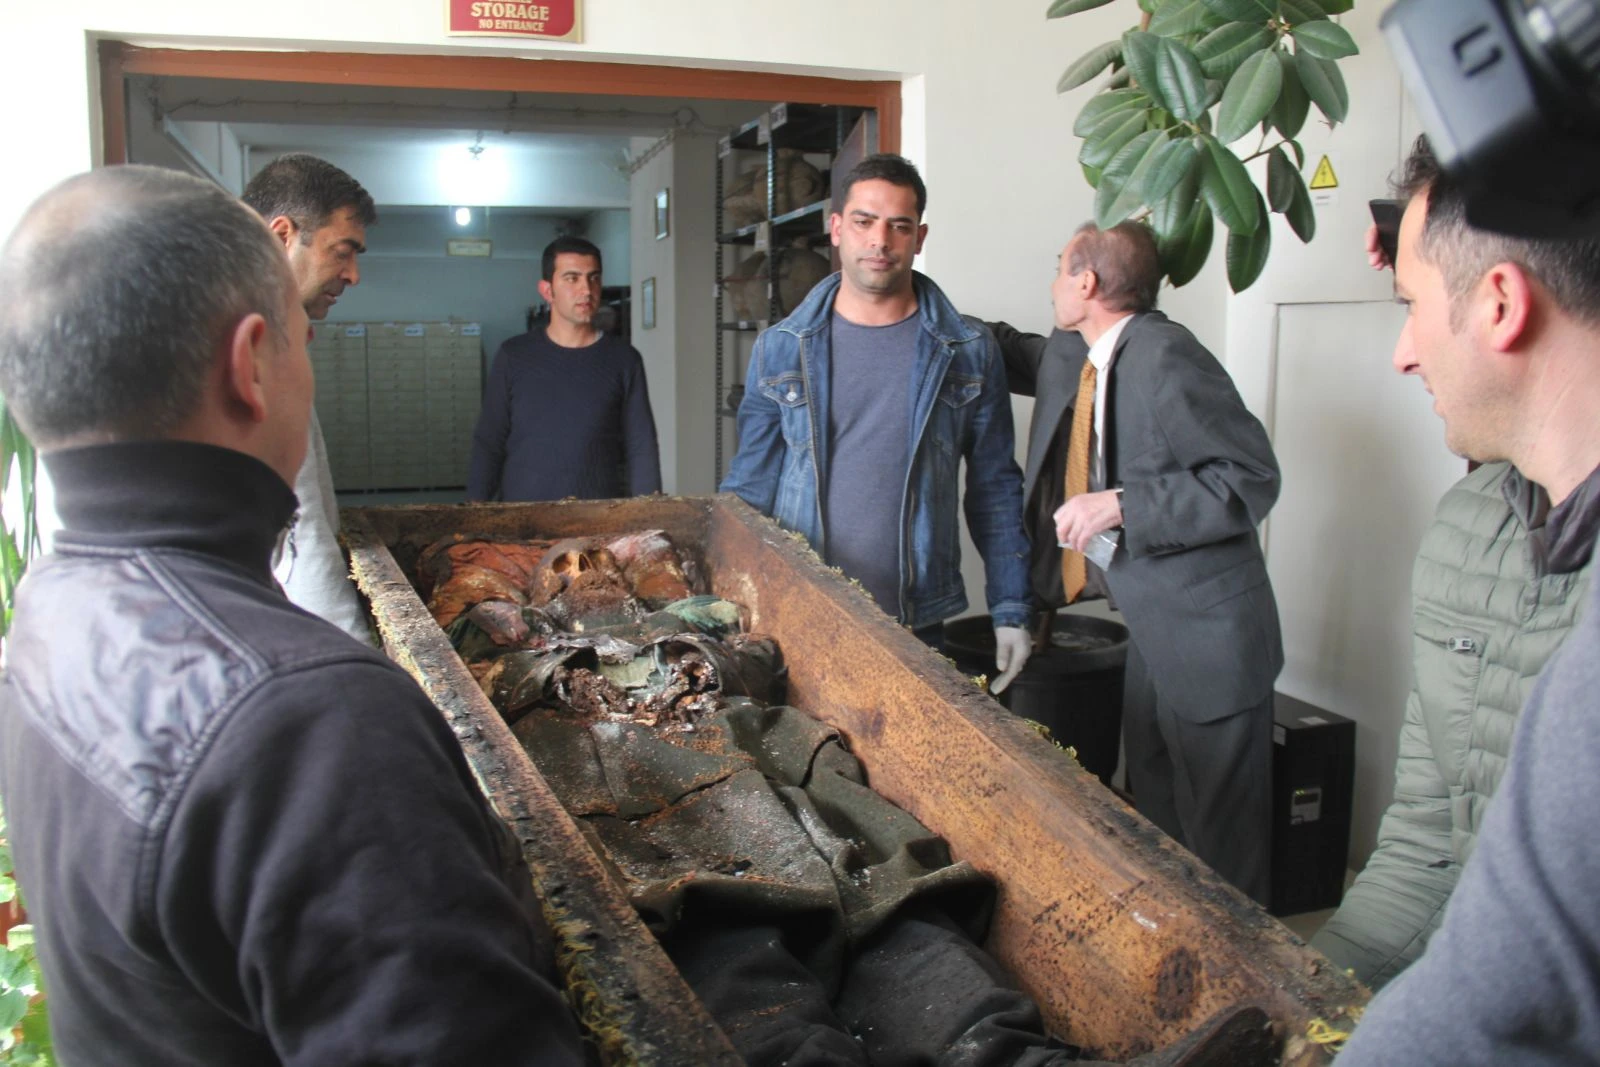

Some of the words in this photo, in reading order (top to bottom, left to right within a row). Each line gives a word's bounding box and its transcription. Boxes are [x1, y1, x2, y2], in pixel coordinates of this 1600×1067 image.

[471, 2, 549, 21] STORAGE
[479, 19, 494, 29] NO
[495, 20, 545, 32] ENTRANCE
